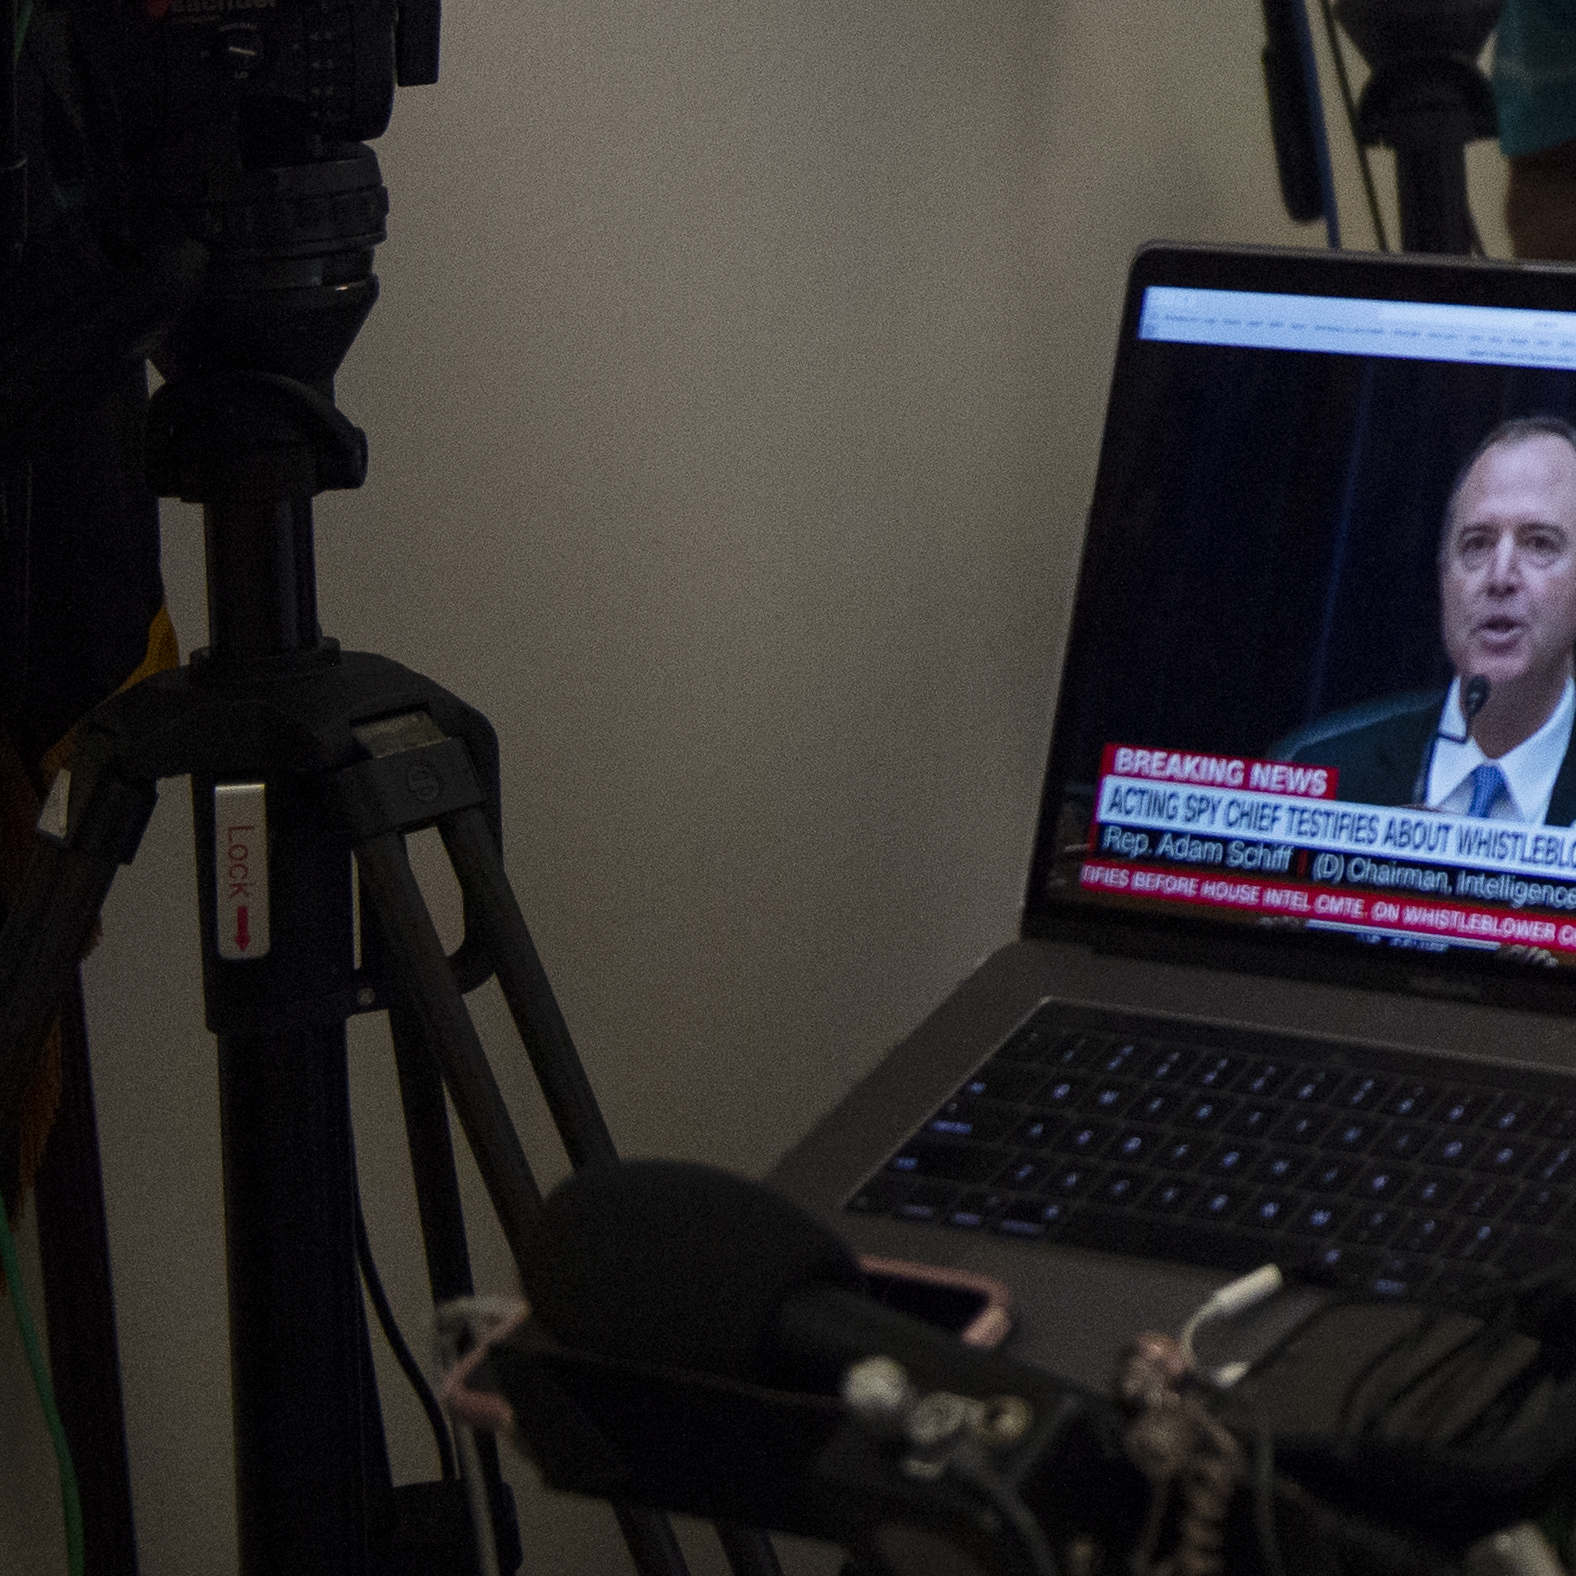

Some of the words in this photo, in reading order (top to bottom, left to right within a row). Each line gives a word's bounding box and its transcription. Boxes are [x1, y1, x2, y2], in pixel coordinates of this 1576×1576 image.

[1114, 747, 1245, 786] BREAKING
[1250, 759, 1329, 796] NEWS
[1108, 787, 1179, 820] ACTING
[1184, 795, 1222, 824] SPY
[1224, 798, 1282, 832] CHIEF
[1285, 806, 1380, 844] TESTIFIES
[1382, 816, 1451, 853] ABOUT
[1102, 825, 1152, 857] Rep.
[1158, 833, 1223, 863] Adam
[1226, 840, 1295, 872] Schiff
[1312, 852, 1345, 884] (D)
[1350, 857, 1452, 894] Chairman,
[1131, 871, 1199, 897] BEFORE
[1201, 879, 1260, 906] HOUSE
[1261, 888, 1311, 912] INTEL
[1371, 900, 1400, 922] ON
[1402, 906, 1556, 942] WHISTLEBLOWER
